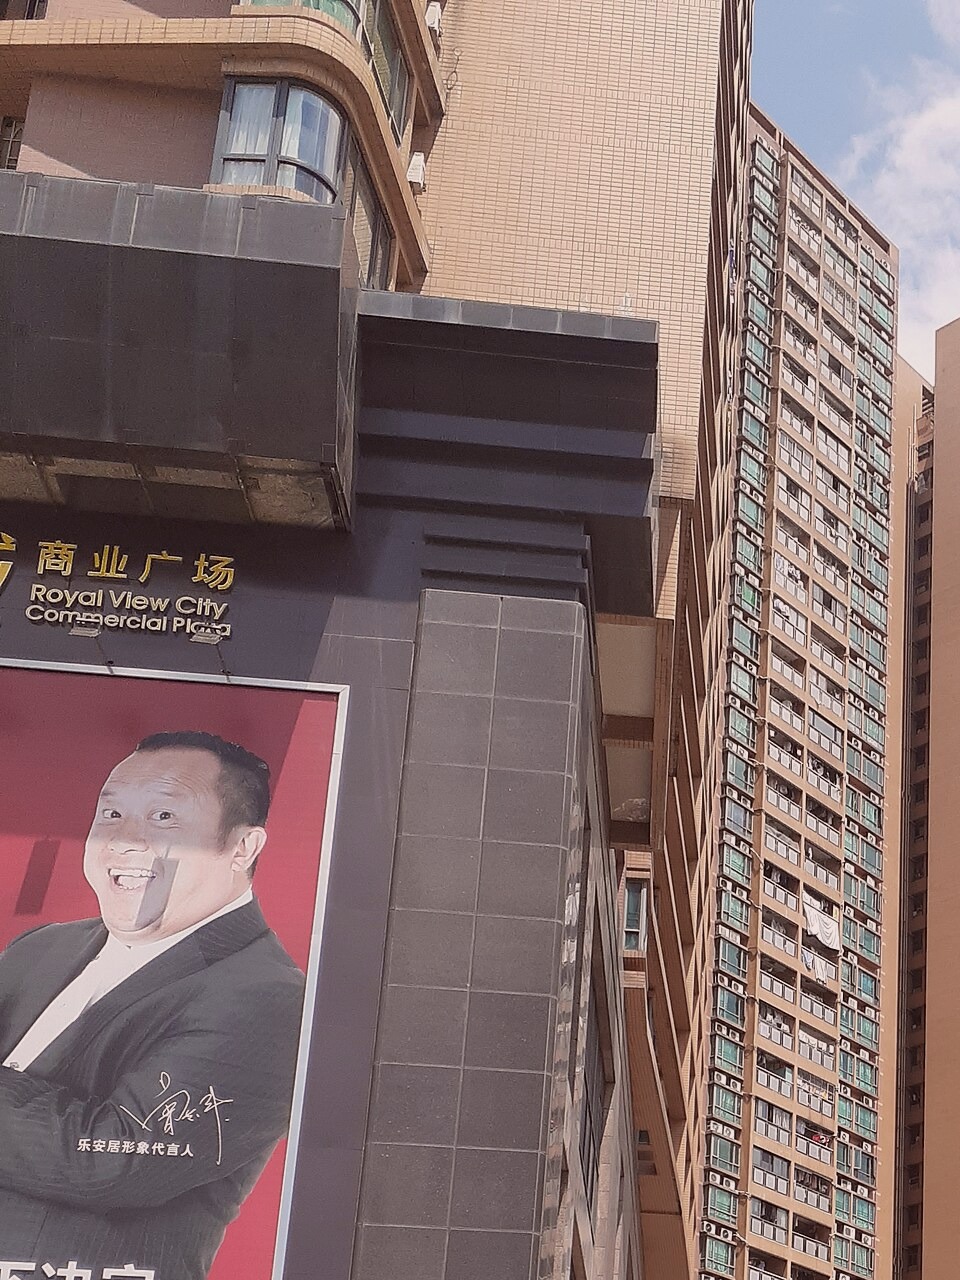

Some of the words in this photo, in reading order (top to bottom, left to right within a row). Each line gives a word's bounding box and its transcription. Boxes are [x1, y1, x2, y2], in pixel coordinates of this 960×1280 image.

[37, 540, 235, 590] 商业广场
[30, 584, 103, 608] Royal
[108, 589, 170, 612] View
[175, 595, 228, 620] City
[172, 617, 231, 637] Plaa
[77, 1138, 194, 1157] 乐安居形象代言人
